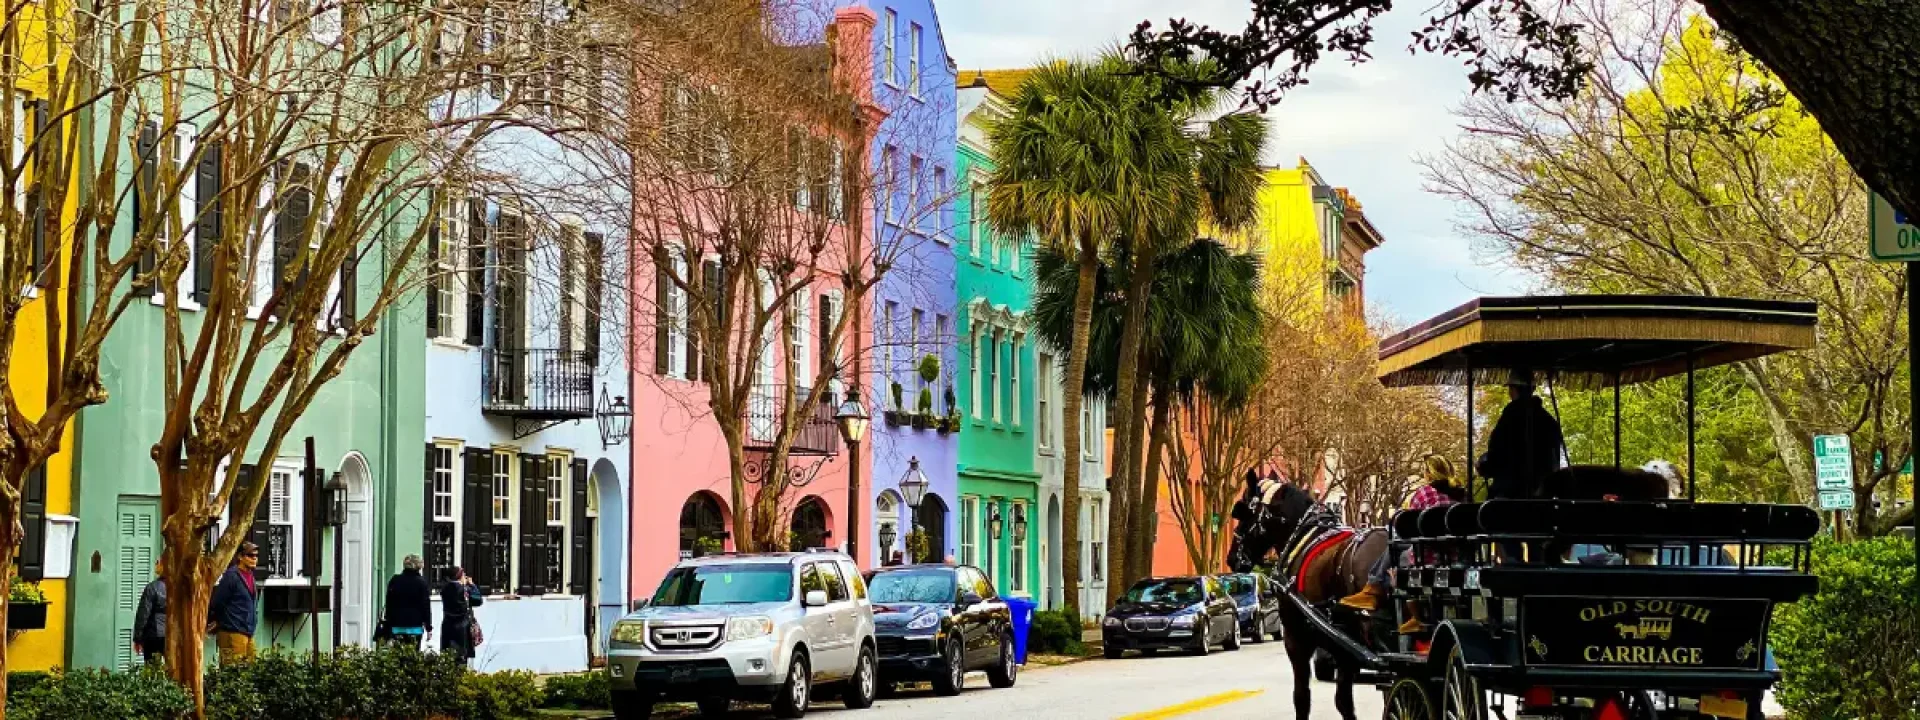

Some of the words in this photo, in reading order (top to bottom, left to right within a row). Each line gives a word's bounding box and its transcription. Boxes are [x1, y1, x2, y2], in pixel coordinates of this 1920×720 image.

[1580, 601, 1628, 621] OLD
[1633, 599, 1711, 624] SOUTH
[1583, 645, 1704, 664] CARRIAGE
